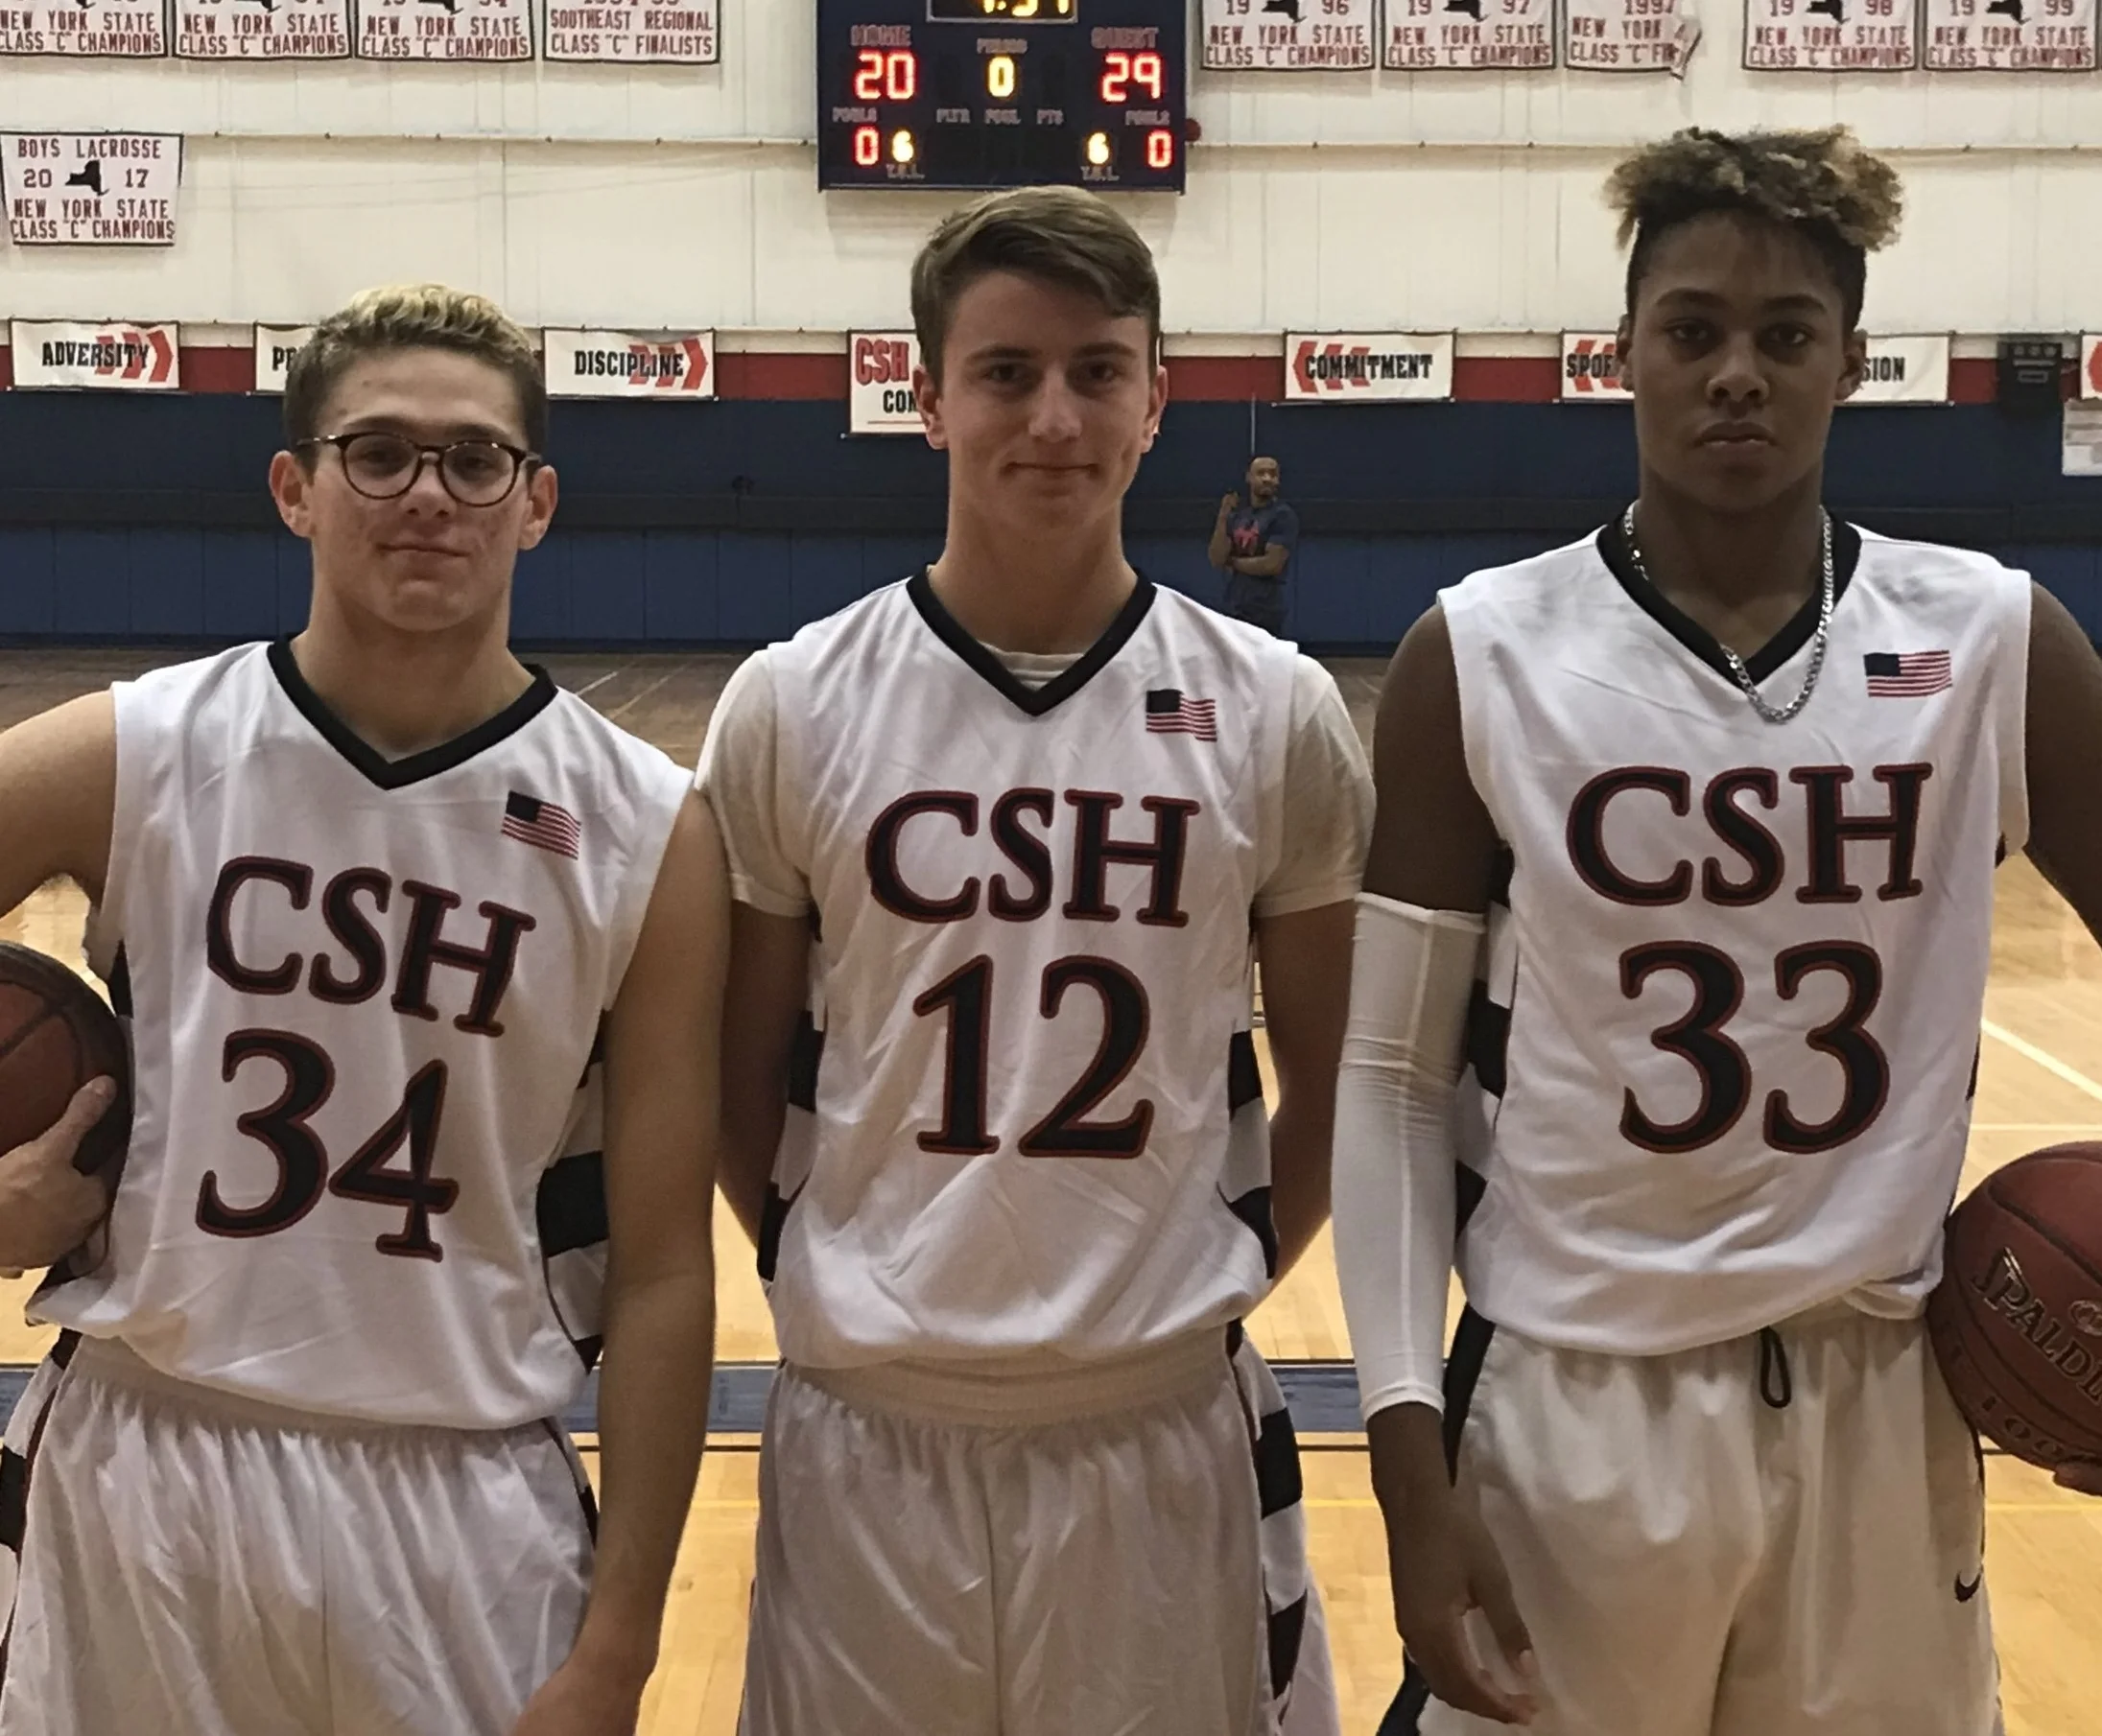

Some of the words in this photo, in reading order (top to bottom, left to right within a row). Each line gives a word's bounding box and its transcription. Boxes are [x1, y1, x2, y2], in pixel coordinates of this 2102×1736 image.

[1226, 0, 1250, 15] 19
[1408, 0, 1432, 16] 19
[1770, 0, 1794, 16] 19
[1950, 0, 1975, 16] 19
[0, 10, 33, 30] NEW
[48, 10, 87, 31] YORK
[103, 12, 155, 32] STATE
[184, 13, 217, 34] NEW
[232, 13, 272, 34] YORK
[288, 13, 339, 34] STATE
[367, 15, 400, 35] NEW
[415, 16, 456, 35] YORK
[470, 16, 521, 36] STATE
[551, 9, 631, 30] SOUTHEAST
[645, 11, 714, 31] REGIONAL
[1572, 17, 1605, 37] NEW
[1622, 19, 1661, 39] YORK
[78, 33, 161, 53] CHAMPIONS
[179, 35, 227, 54] CLASS
[263, 35, 346, 55] CHAMPIONS
[552, 34, 600, 54] CLASS
[636, 35, 713, 55] FINALISTS
[1211, 26, 1243, 45] NEW
[1259, 25, 1298, 45] YORK
[1312, 25, 1364, 45] STATE
[1394, 26, 1426, 45] NEW
[1441, 25, 1480, 45] YORK
[1495, 24, 1545, 44] STATE
[1756, 26, 1787, 45] NEW
[1803, 26, 1842, 45] YORK
[1856, 26, 1906, 45] STATE
[1935, 26, 1967, 45] NEW
[1982, 26, 2021, 45] YORK
[2036, 26, 2088, 45] STATE
[362, 35, 411, 56] CLASS
[446, 36, 528, 58] CHAMPIONS
[1206, 47, 1253, 65] CLASS
[1287, 47, 1370, 65] CHAMPIONS
[1389, 47, 1435, 65] CLASS
[1471, 45, 1550, 65] CHAMPIONS
[1571, 41, 1618, 63] CLASS
[1750, 46, 1797, 65] CLASS
[1831, 47, 1912, 65] CHAMPIONS
[855, 51, 914, 100] 20
[988, 56, 1015, 97] 0
[1102, 52, 1161, 102] 29
[18, 138, 60, 157] BOYS
[76, 139, 161, 158] LACROSSE
[855, 127, 880, 166] 0
[892, 130, 913, 163] 6
[1088, 132, 1109, 164] 6
[1147, 130, 1171, 168] 0
[24, 169, 52, 188] 20
[126, 169, 150, 188] 17
[14, 199, 46, 218] NEW
[62, 199, 102, 218] YORK
[117, 199, 169, 219] STATE
[11, 219, 58, 239] CLASS
[93, 220, 175, 239] CHAMPIONS
[42, 341, 150, 369] ADVERSITY
[574, 349, 684, 378] DISCIPLINE
[856, 338, 909, 386] CSH
[1305, 354, 1433, 380] COMMITMENT
[1566, 762, 1933, 906] CSH
[865, 787, 1201, 928] CSH
[206, 856, 536, 1037] CSH
[913, 954, 1155, 1159] 12
[1618, 940, 1890, 1155] 33
[196, 1028, 460, 1262] 34
